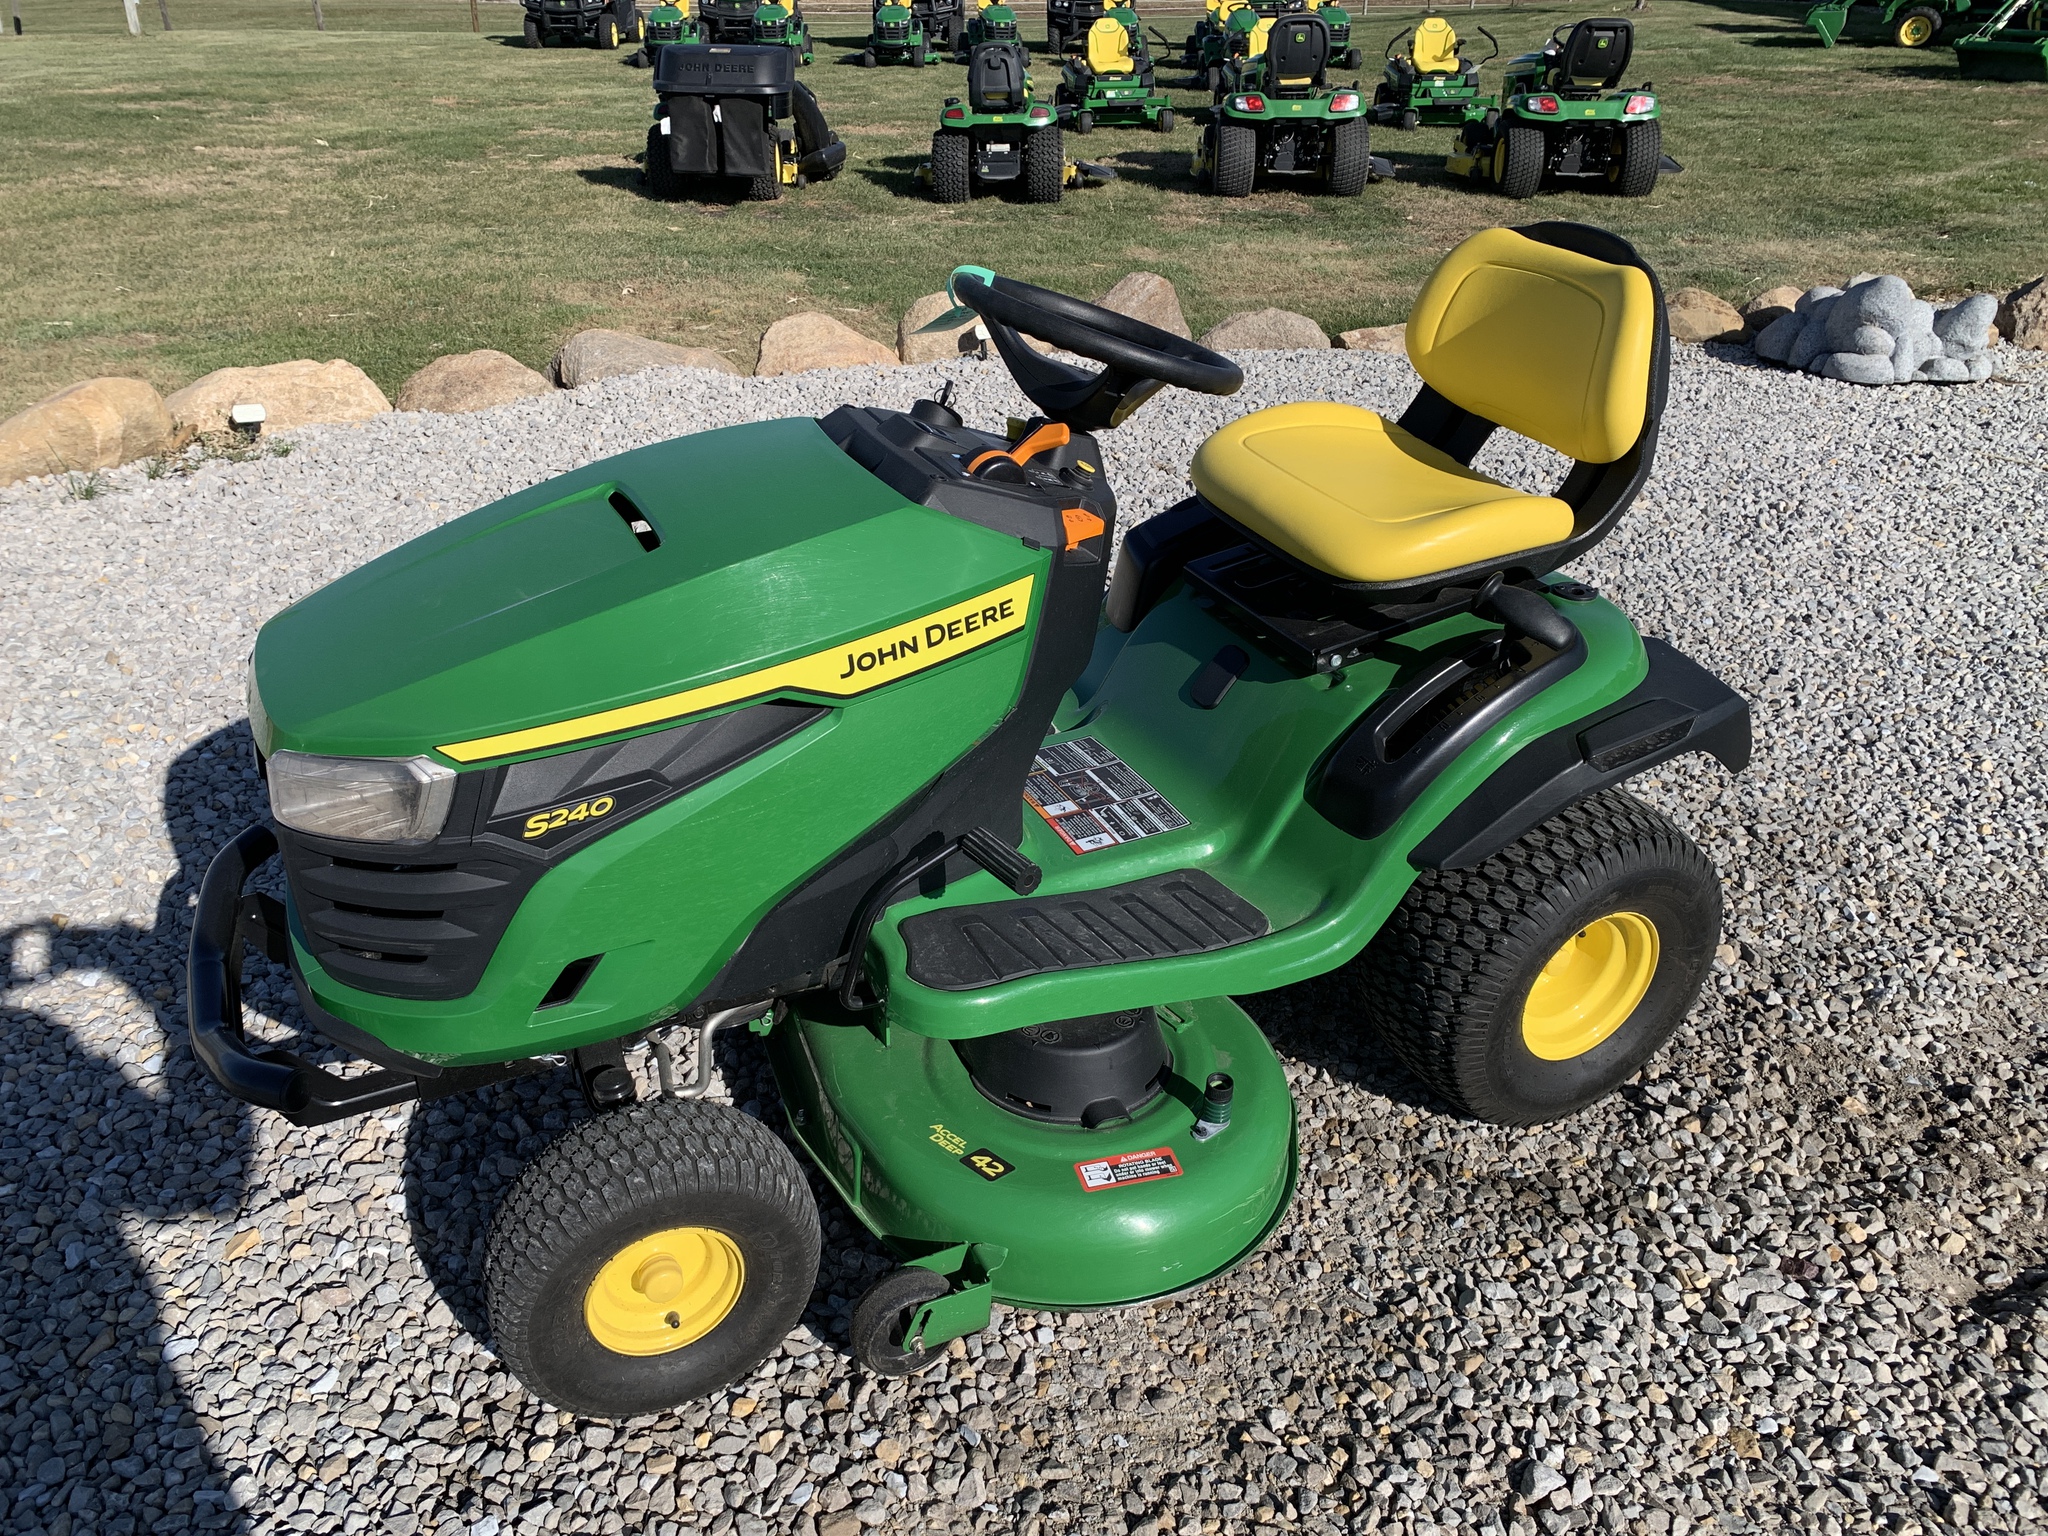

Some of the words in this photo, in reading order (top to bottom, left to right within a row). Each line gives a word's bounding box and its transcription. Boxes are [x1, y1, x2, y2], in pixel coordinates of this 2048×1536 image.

[679, 63, 710, 72] JOHN
[714, 63, 754, 74] DEERE
[840, 624, 919, 680] JOHN
[925, 598, 1015, 649] DEERE
[523, 796, 615, 838] S240
[929, 1124, 967, 1149] ACCEL
[929, 1133, 964, 1155] DEEP
[970, 1155, 1005, 1177] 42
[1127, 1151, 1156, 1160] DANGER
